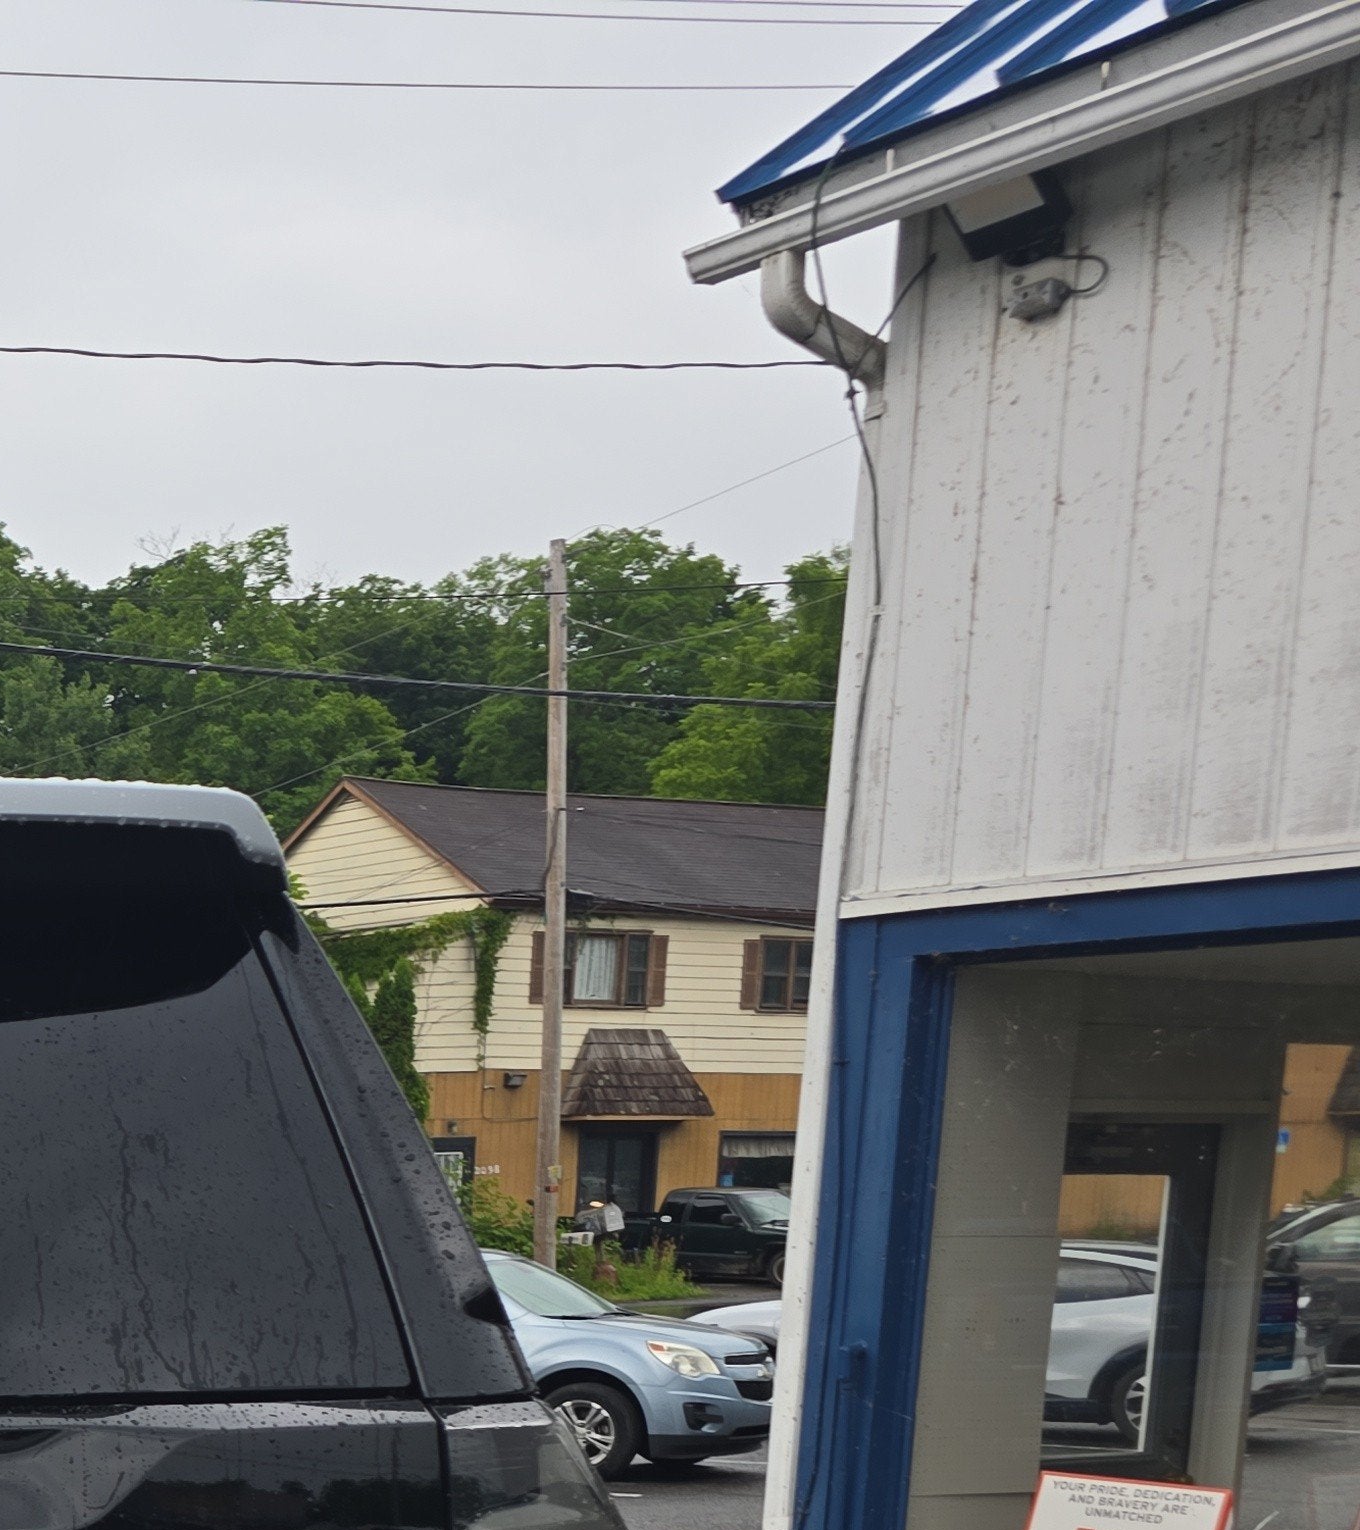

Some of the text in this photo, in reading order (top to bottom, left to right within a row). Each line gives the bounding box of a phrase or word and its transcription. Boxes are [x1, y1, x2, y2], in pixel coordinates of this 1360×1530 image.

[1053, 1481, 1086, 1491] YOUR
[1133, 1489, 1216, 1507] DEDICATION,
[1068, 1494, 1189, 1516] AND BRAVERY ARE
[1085, 1507, 1163, 1524] UNMATCHED
